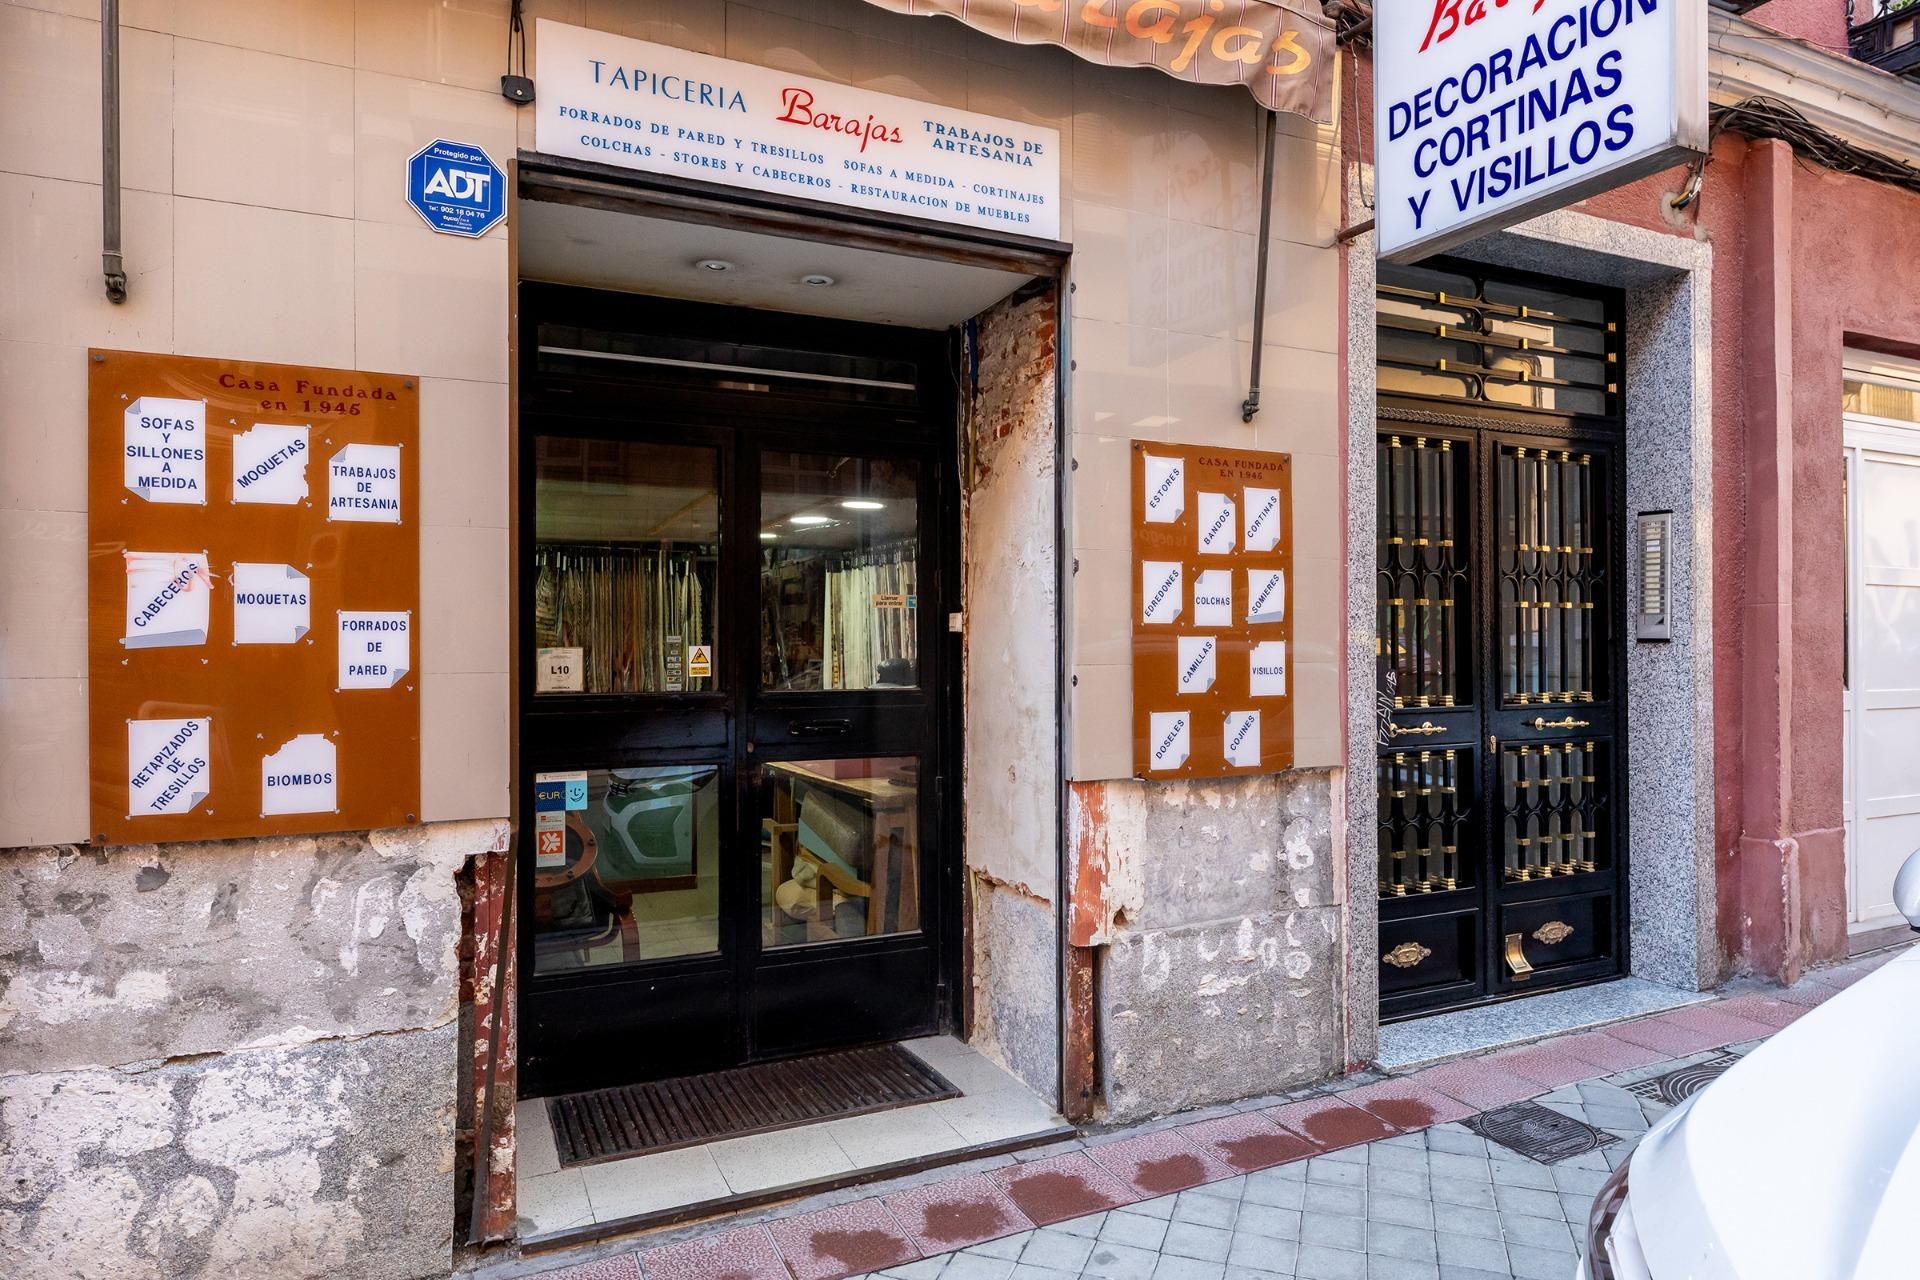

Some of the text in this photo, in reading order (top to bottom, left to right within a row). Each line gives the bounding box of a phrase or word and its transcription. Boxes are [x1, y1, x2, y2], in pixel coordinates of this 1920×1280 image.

[588, 59, 747, 114] TAPICERIA
[775, 87, 904, 153] Barajas
[1413, 49, 1623, 179] CORTINAS
[559, 106, 824, 164] FORRADOS DE PARED Y TRESILLOS
[923, 120, 1044, 155] TRABAJOS DE
[434, 147, 468, 160] Protegido
[932, 138, 1033, 167] ARTESANIA
[1408, 103, 1634, 230] Y VISILLOS
[425, 167, 490, 203] ADT
[581, 135, 652, 156] COLCHAS
[673, 152, 727, 170] STORES
[735, 162, 744, 173] Y
[752, 166, 832, 188] CABECEROS
[851, 183, 948, 208] RESTAURACION
[956, 201, 971, 212] DE
[977, 206, 1031, 223] MUEBLES
[844, 159, 882, 175] SOFAS
[890, 168, 898, 178] A
[905, 171, 955, 188] MEDIDA
[973, 183, 1045, 205] CORTINAJES
[440, 206, 454, 214] 902
[219, 374, 397, 401] Casa Fundada
[261, 400, 288, 411] en
[140, 417, 194, 432] SOFAS
[161, 433, 171, 444] Y
[126, 445, 204, 461] SILLONES
[236, 438, 306, 488] MOQUETAS
[1198, 456, 1284, 472] CASA FUNDADA
[162, 462, 172, 474] A
[332, 465, 397, 480] TRABAJOS
[1220, 469, 1234, 478] EN
[138, 476, 198, 490] MEDIDA
[356, 482, 373, 493] DE
[1149, 468, 1180, 509] ESTORES
[330, 497, 399, 510] ARTESANIA
[1203, 509, 1230, 545] BANDOS
[1247, 495, 1277, 538] CORTINAS
[236, 593, 307, 606] MOQUETAS
[1144, 569, 1179, 617] EDREDONES
[1195, 596, 1230, 606] COLCHAS
[1251, 574, 1280, 614] SOMIERES
[341, 620, 407, 632] FORRADOS
[367, 642, 383, 653] DE
[349, 665, 388, 676] PARED
[551, 665, 570, 675] L10
[1182, 641, 1213, 684] CAMILLAS
[1252, 666, 1283, 675] VISILLOS
[1155, 719, 1185, 760] DOSELES
[1230, 715, 1255, 751] COJINES
[131, 720, 199, 789] RETAPIZADOS
[166, 757, 185, 774] DE
[150, 757, 206, 811] TRESILLOS
[267, 773, 332, 787] BIOMBOS
